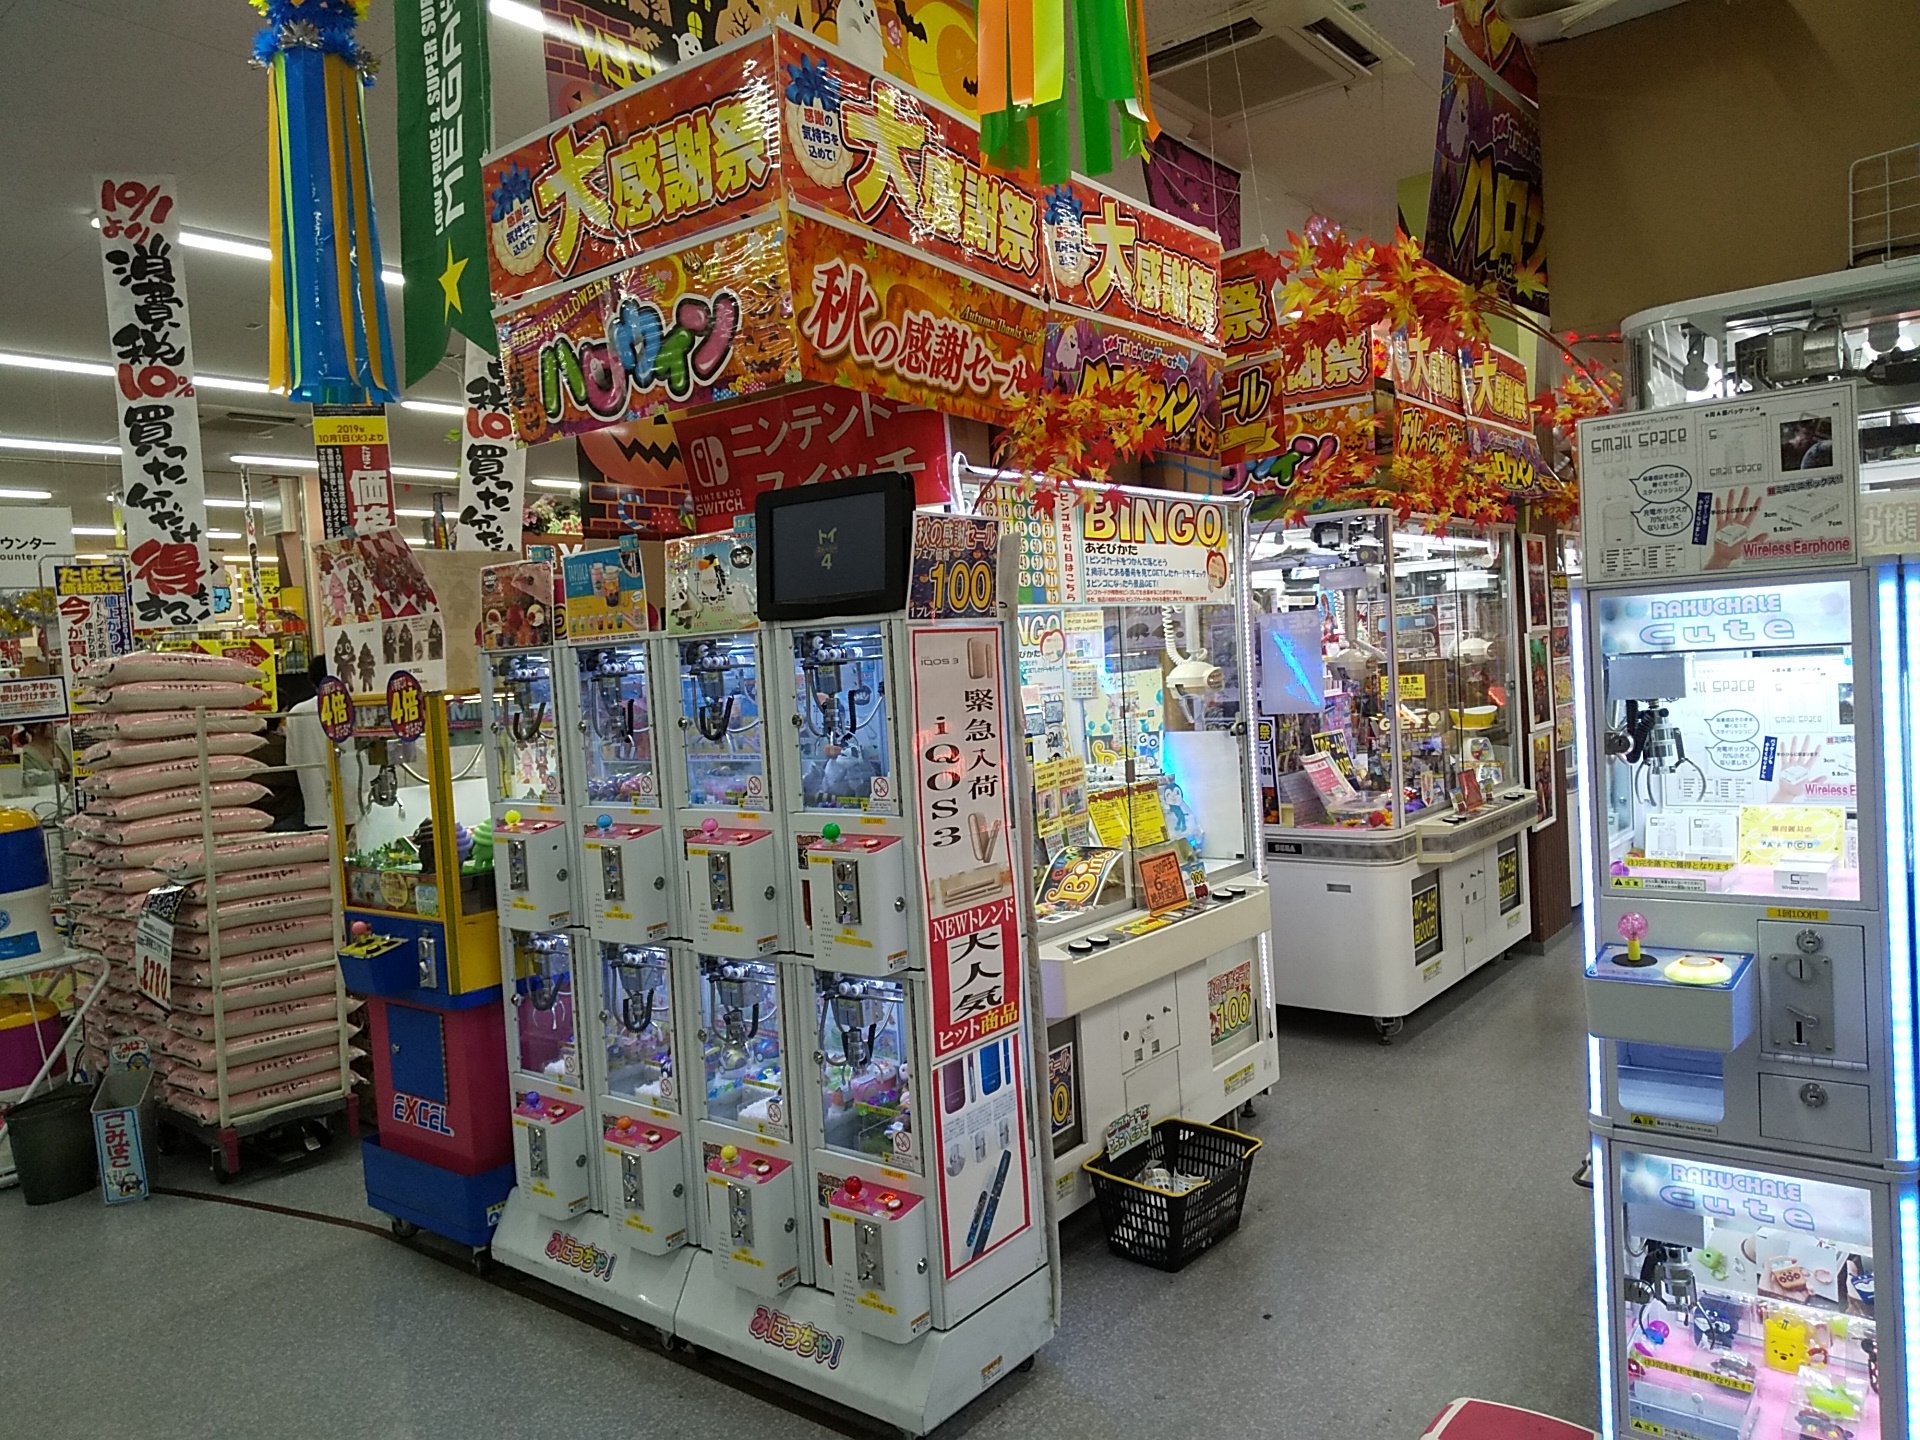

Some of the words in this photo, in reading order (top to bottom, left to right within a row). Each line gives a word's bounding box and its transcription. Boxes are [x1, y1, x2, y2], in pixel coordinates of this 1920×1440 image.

[424, 40, 441, 106] SUPER
[430, 108, 441, 123] &
[804, 107, 832, 127] 感謝の
[801, 126, 839, 146] 気持ちを
[808, 145, 836, 162] 込めて!
[430, 125, 443, 187] PRICE
[434, 190, 443, 236] LOW
[961, 307, 996, 329] Autumn
[997, 317, 1023, 340] Thanks
[1023, 327, 1039, 345] Sale
[541, 289, 741, 421] ハロウィン
[118, 363, 195, 400] 10%
[694, 488, 742, 502] NINTENDO
[695, 498, 745, 517] SWITCH
[915, 517, 997, 551] 秋の感謝セール
[1083, 494, 1223, 547] BINGO
[821, 553, 833, 570] 4
[1085, 543, 1138, 555] あそびかた
[1743, 541, 1793, 559] Wireless
[1793, 539, 1850, 558] Earphone
[930, 560, 993, 614] 100
[1651, 594, 1782, 620] RAKUCHALE
[1640, 619, 1795, 646] Cute
[321, 691, 348, 726] 4倍
[391, 687, 419, 725] 4倍
[964, 688, 998, 800] 緊急入荷
[1805, 783, 1848, 796] Wireless
[932, 898, 1014, 943] NEWトレンド
[951, 932, 1003, 1020] 大人気
[939, 1001, 1019, 1050] ヒット商品
[1217, 991, 1250, 1034] 100
[392, 1093, 452, 1137] EXCEL
[1671, 1164, 1802, 1203] RAKUCHALE
[1659, 1185, 1816, 1232] Cute
